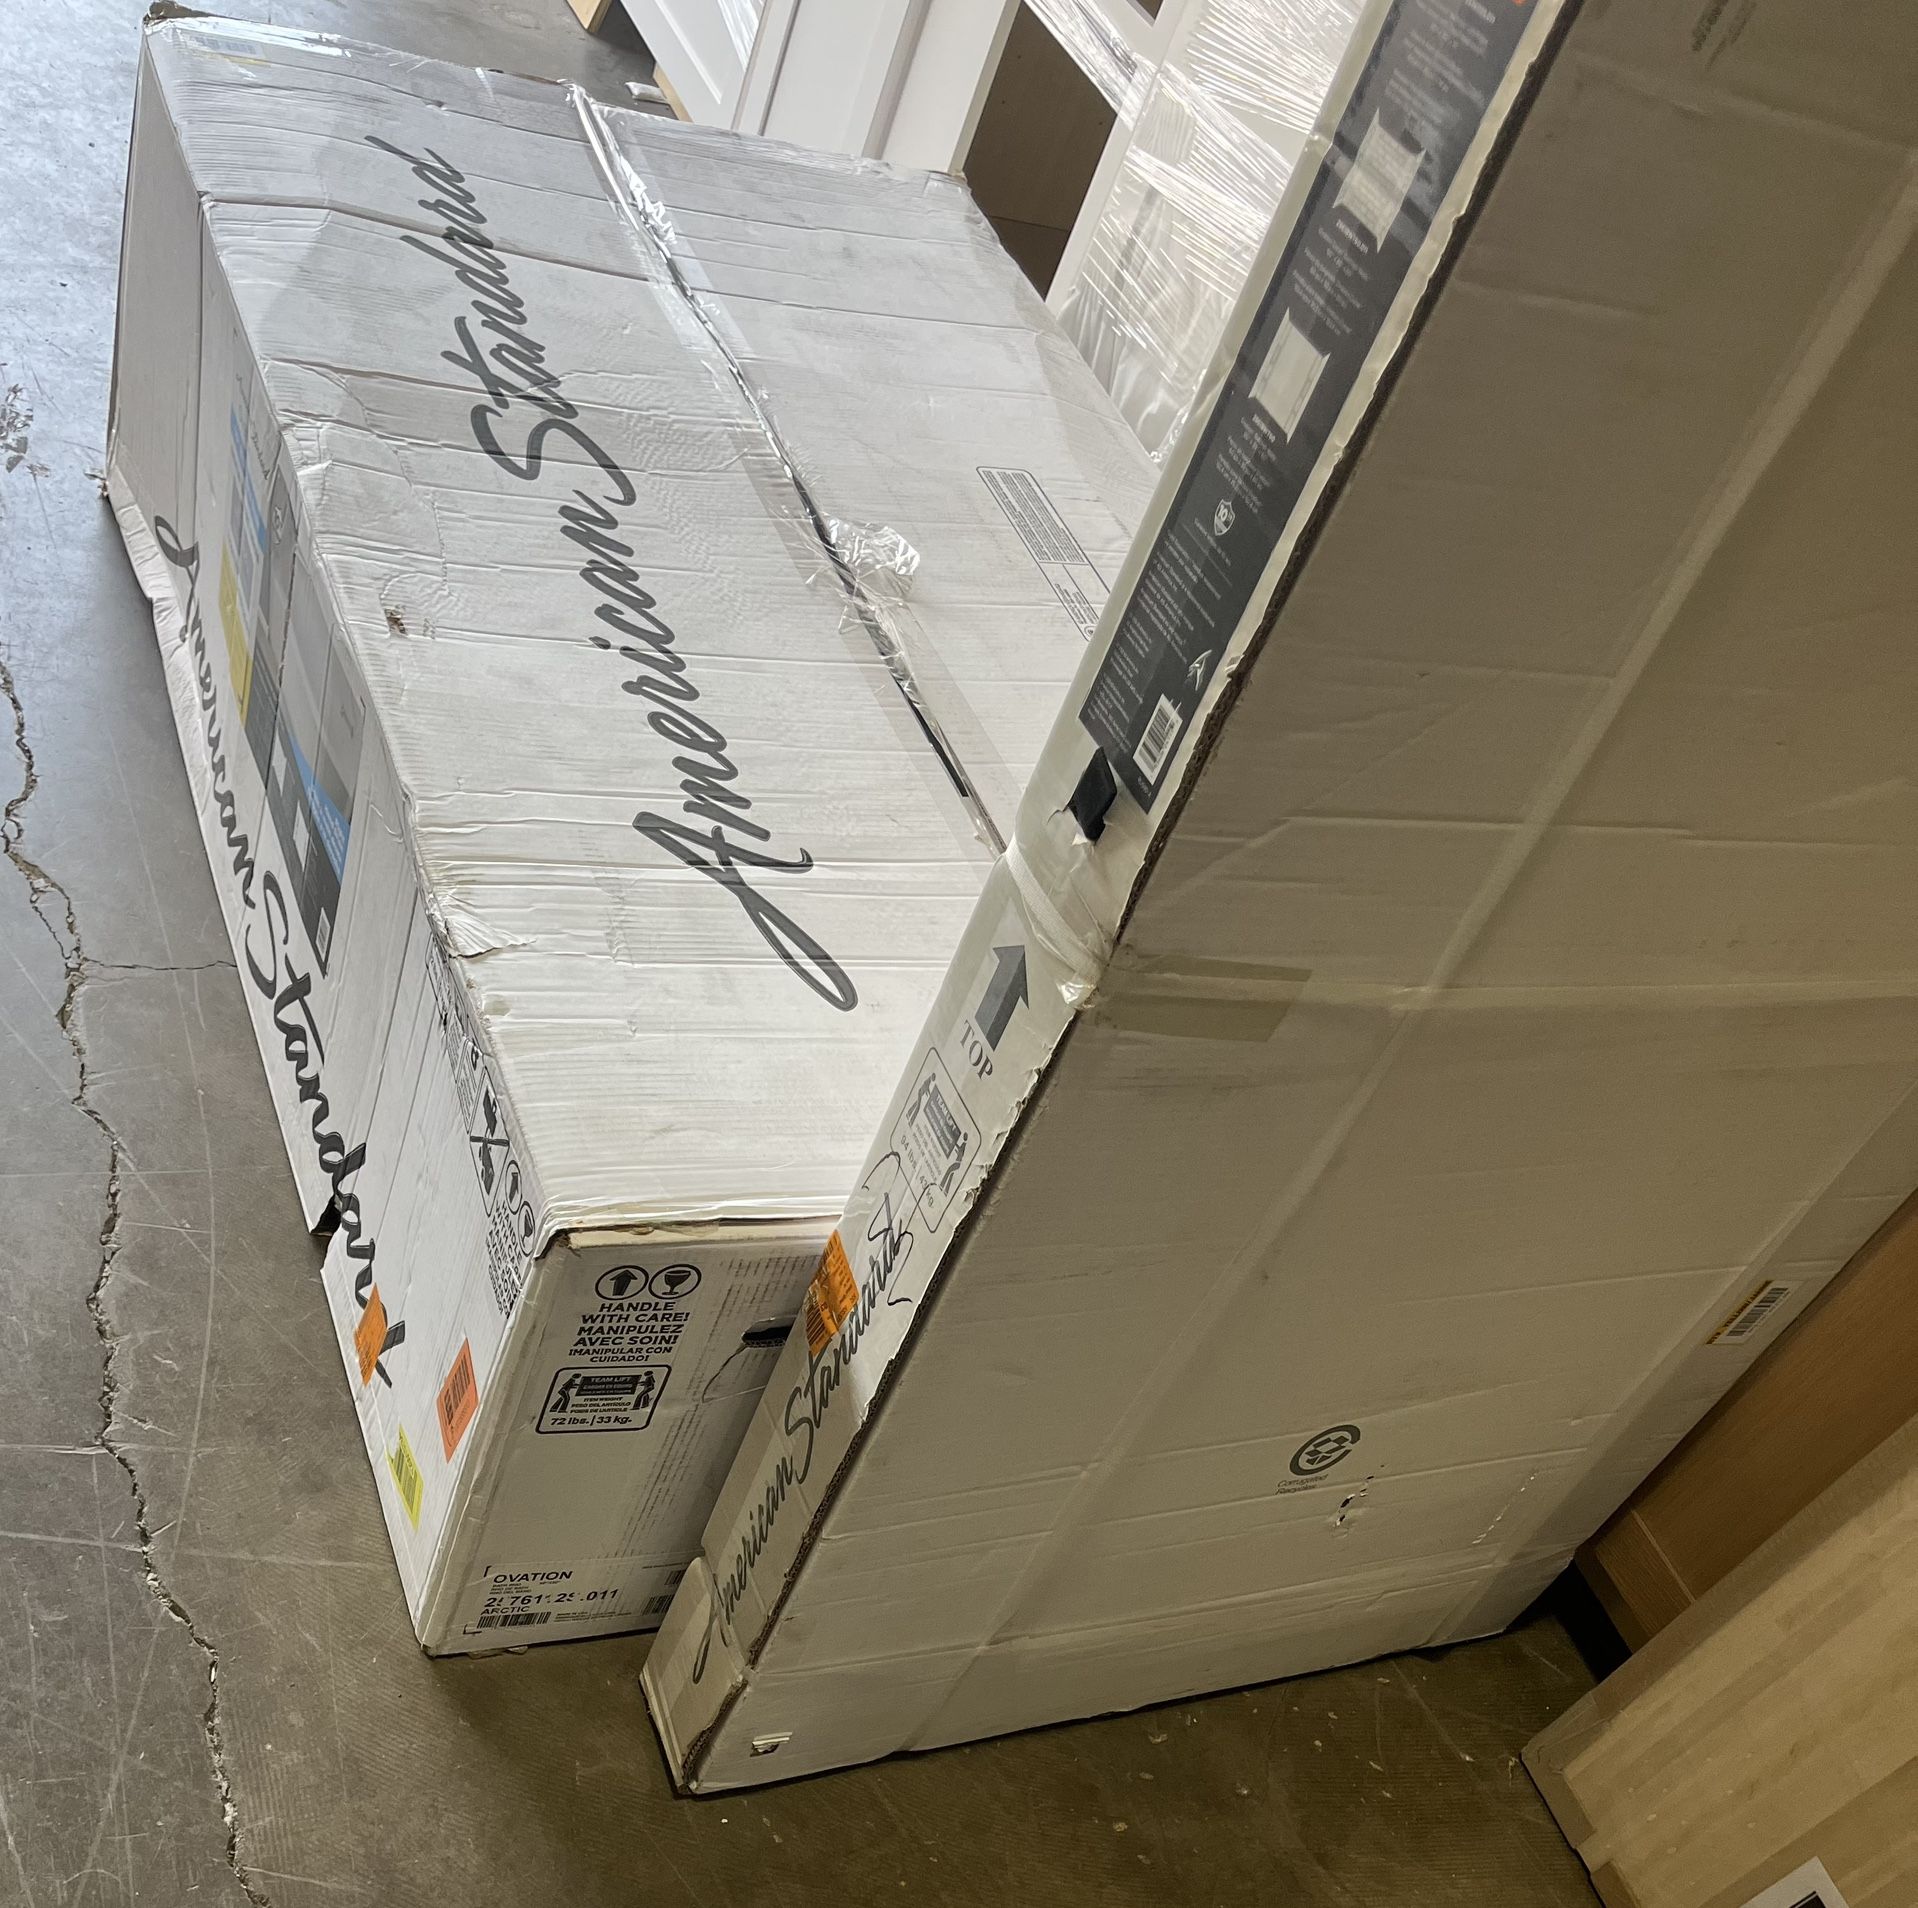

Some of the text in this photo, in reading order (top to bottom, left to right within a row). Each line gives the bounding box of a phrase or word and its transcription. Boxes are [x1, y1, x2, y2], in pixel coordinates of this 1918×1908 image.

[366, 135, 858, 1012] American Standard
[960, 1019, 993, 1080] TOP
[599, 1301, 676, 1312] HANDLE
[581, 1312, 690, 1324] WITH CARE!
[577, 1324, 685, 1336] MANIPULEZ
[573, 1335, 679, 1347] AVEC SOIN!
[645, 1346, 673, 1354] CON
[590, 1355, 650, 1363] CUIDADO!
[550, 1418, 567, 1426] 72
[596, 1416, 611, 1424] 33
[692, 1454, 795, 1684] American
[493, 1571, 573, 1583] OVATION
[480, 1606, 530, 1615] ARCTIC
